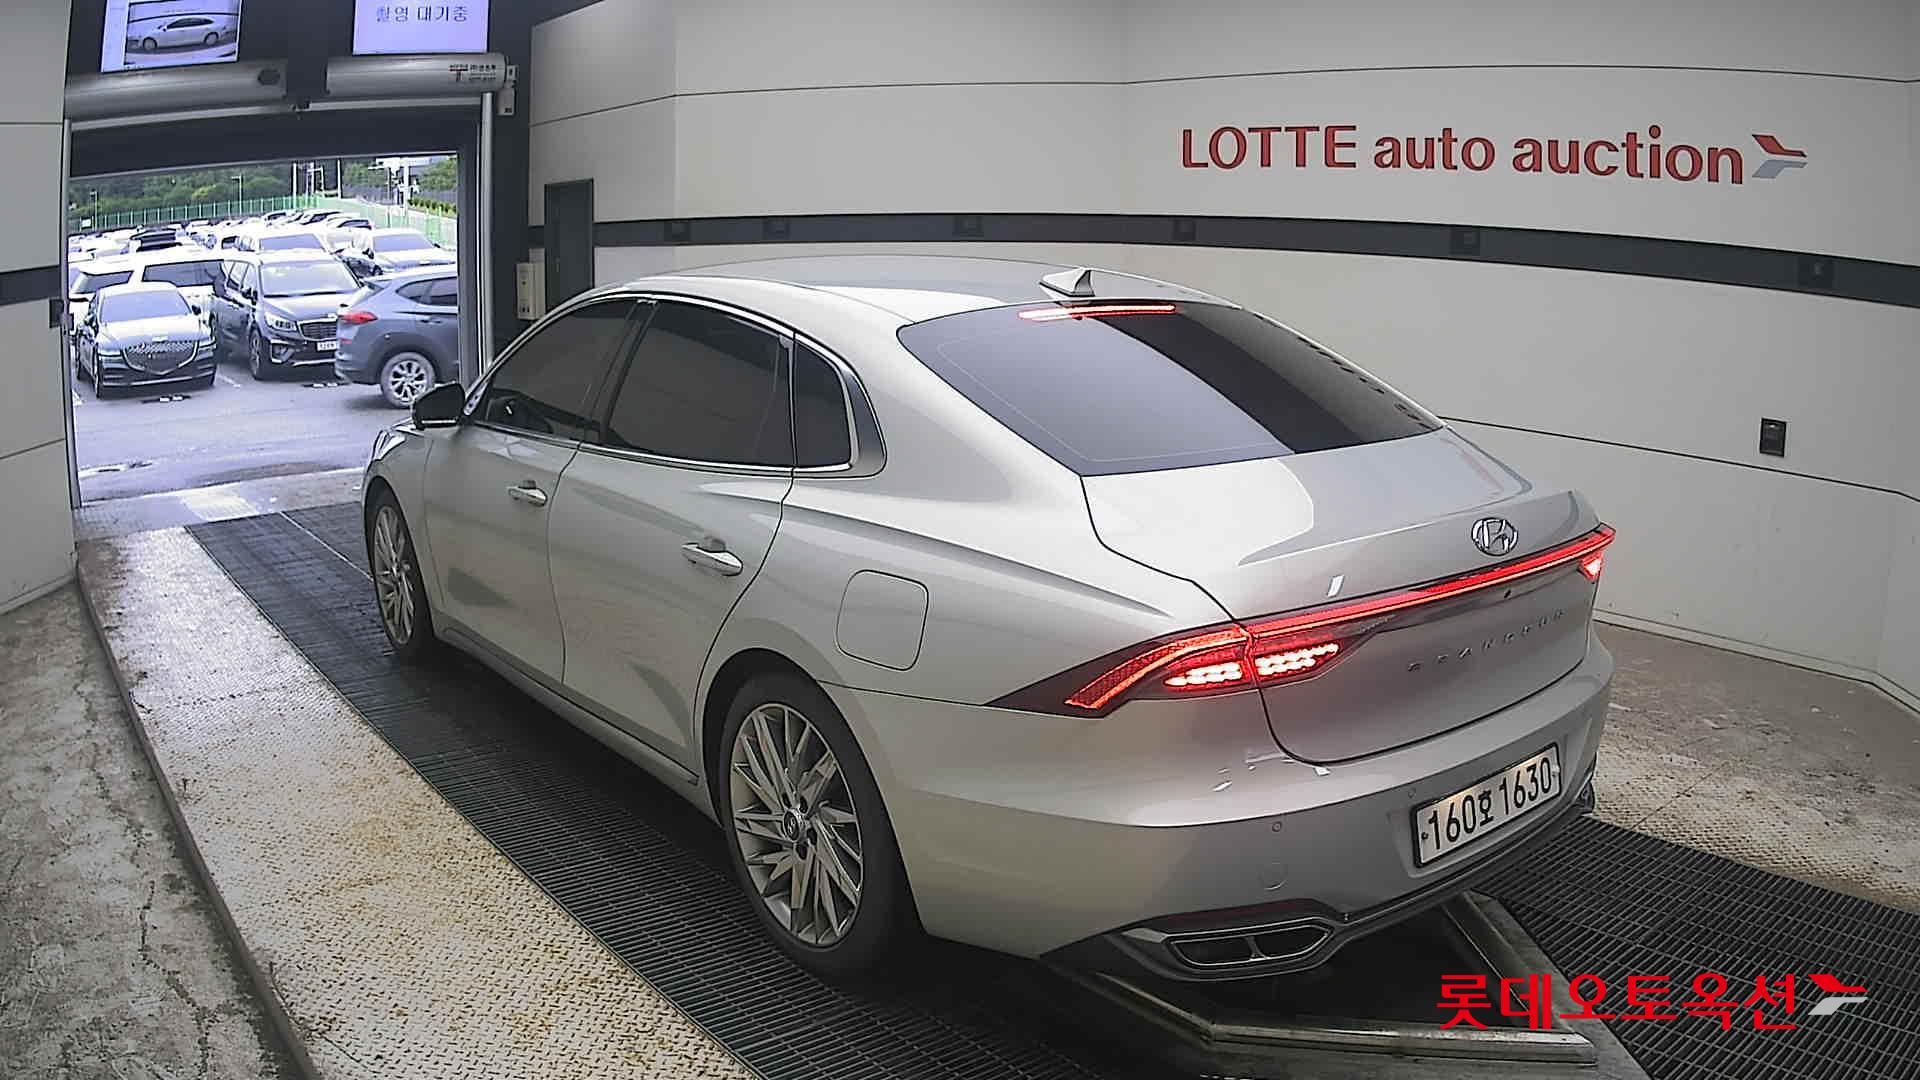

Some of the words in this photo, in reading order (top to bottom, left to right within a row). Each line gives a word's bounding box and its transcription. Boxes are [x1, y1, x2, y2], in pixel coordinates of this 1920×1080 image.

[417, 6, 467, 22] 대기중
[1182, 125, 1357, 169] LOTTE
[1374, 127, 1496, 171] auto
[1512, 125, 1743, 185] auction
[1428, 790, 1494, 850] 160호
[1499, 757, 1551, 816] 1630
